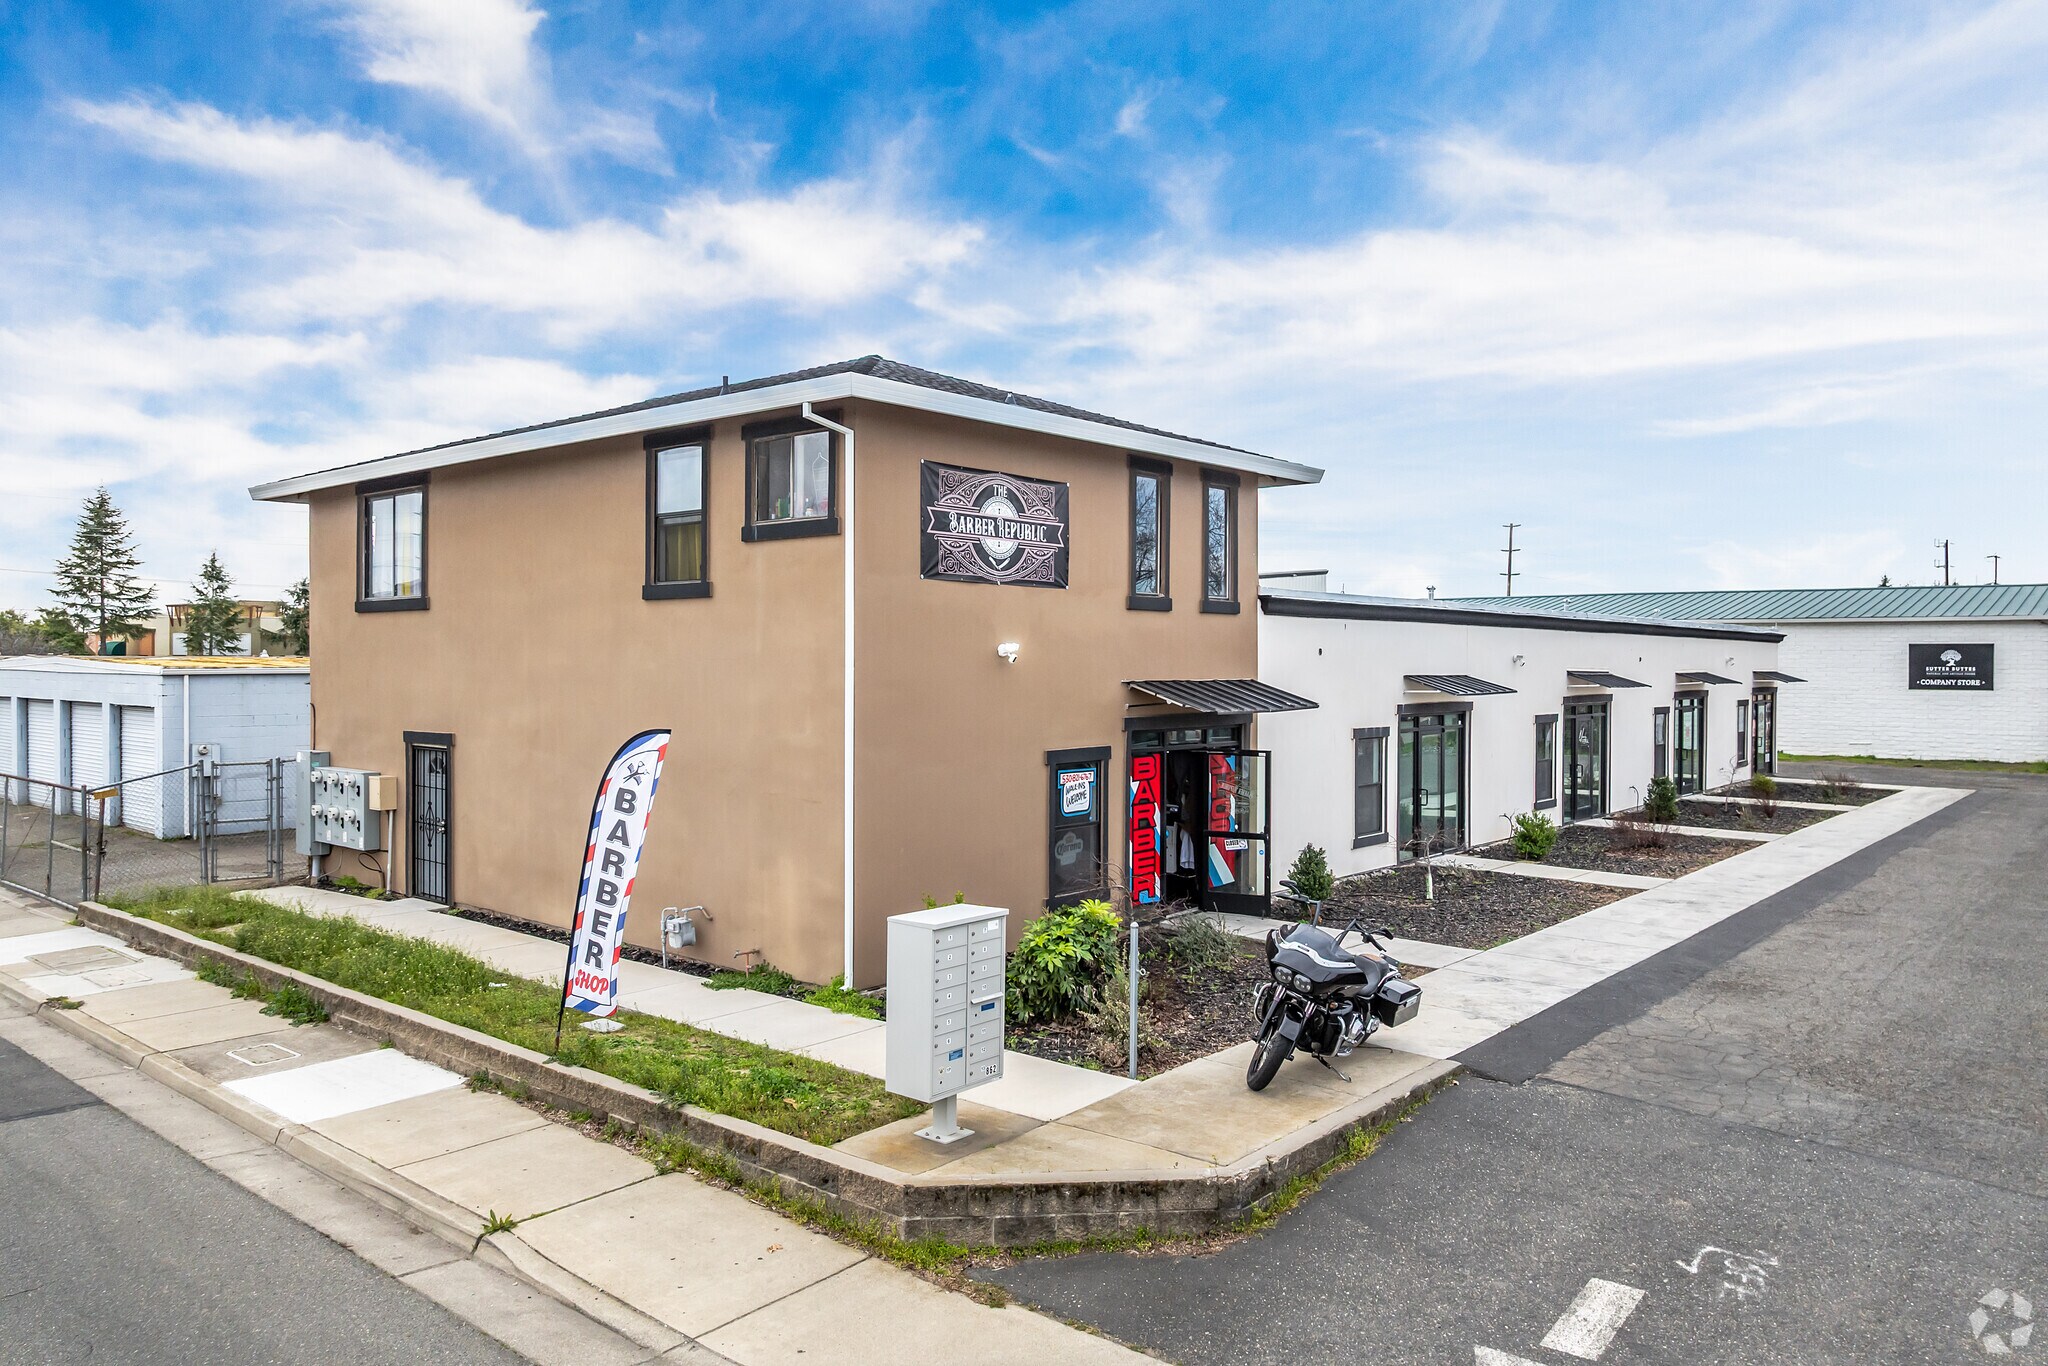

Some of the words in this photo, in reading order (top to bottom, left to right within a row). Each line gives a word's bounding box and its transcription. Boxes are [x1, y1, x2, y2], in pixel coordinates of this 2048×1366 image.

[993, 484, 1008, 498] THE
[949, 511, 996, 537] BARBER
[997, 516, 1047, 543] REPUBLIC
[1132, 755, 1157, 901] BARBER
[584, 787, 636, 971] BARBER
[575, 968, 609, 996] SHOP
